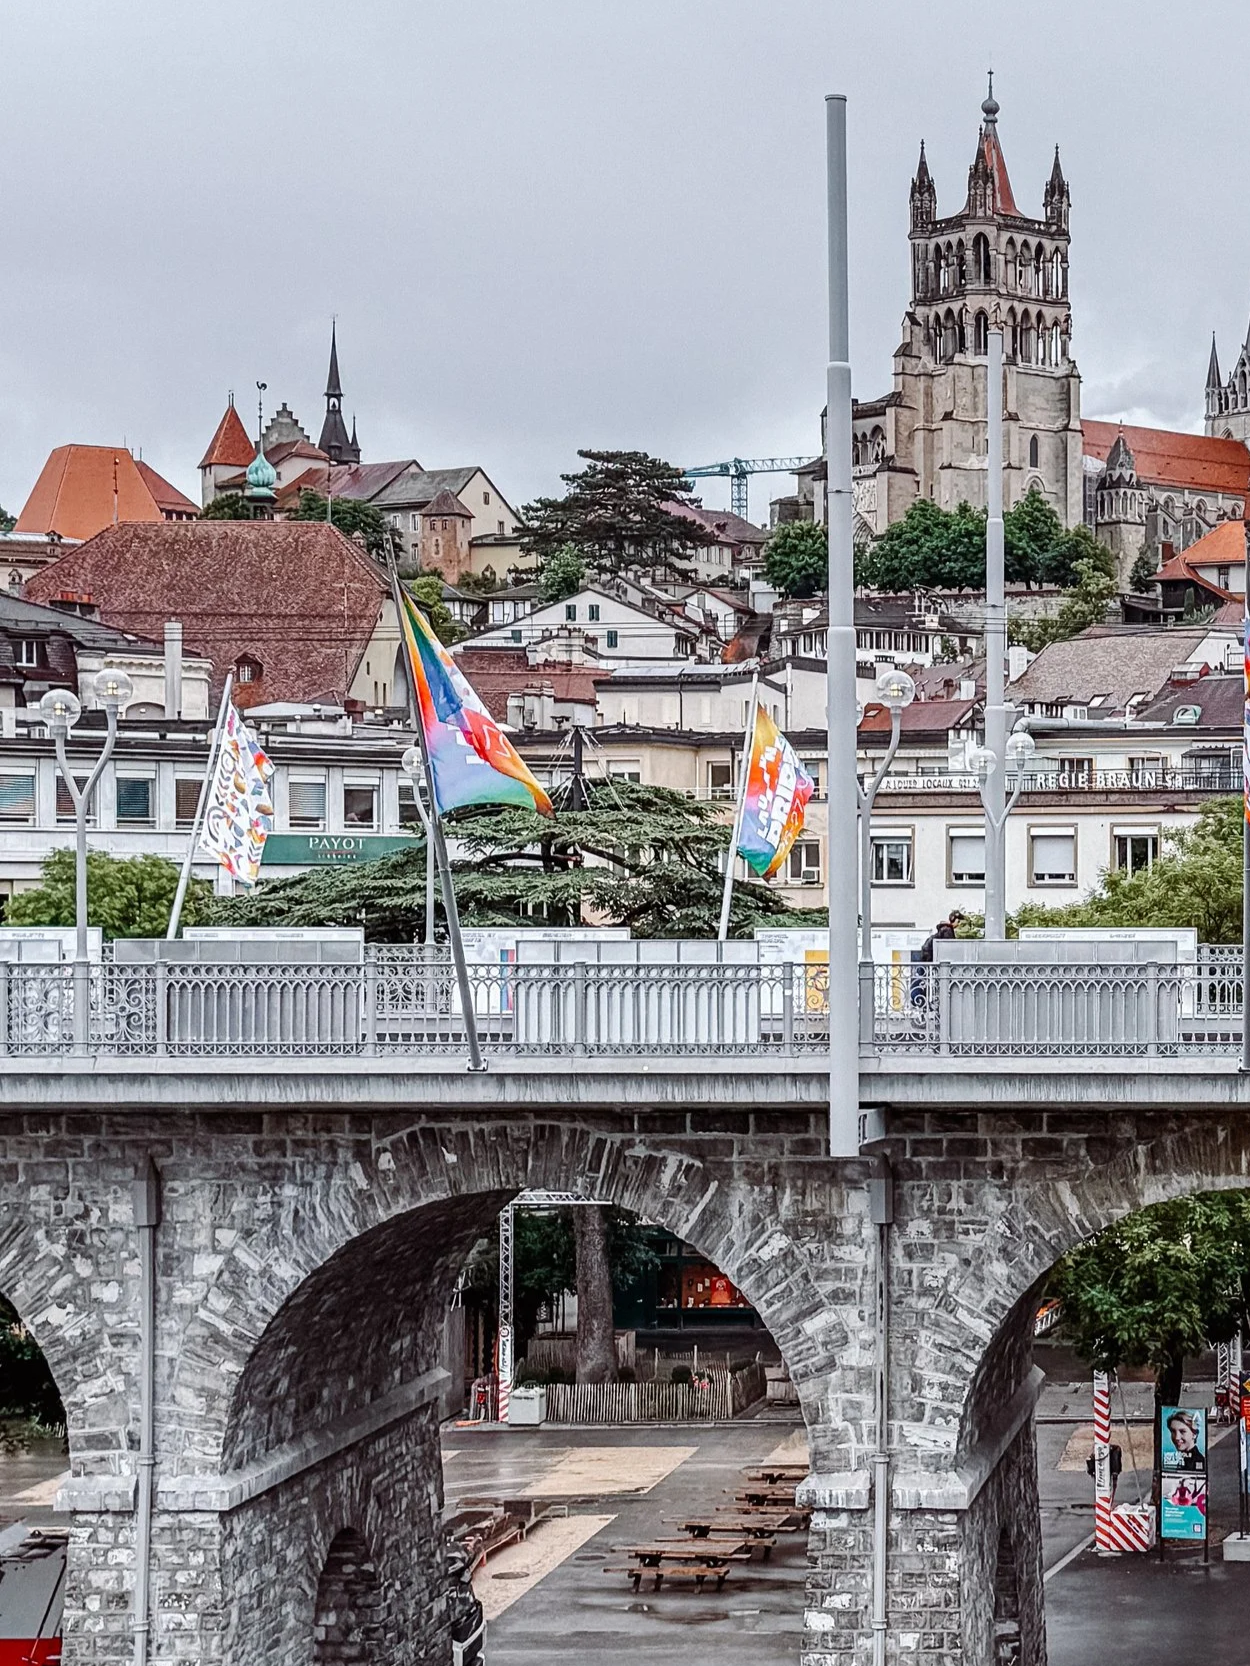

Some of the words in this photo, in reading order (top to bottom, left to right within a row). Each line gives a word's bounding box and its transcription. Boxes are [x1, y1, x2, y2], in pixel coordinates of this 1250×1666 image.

[1036, 771, 1090, 789] REGIE
[1095, 771, 1157, 789] BRAUN
[309, 837, 366, 849] PAYOT
